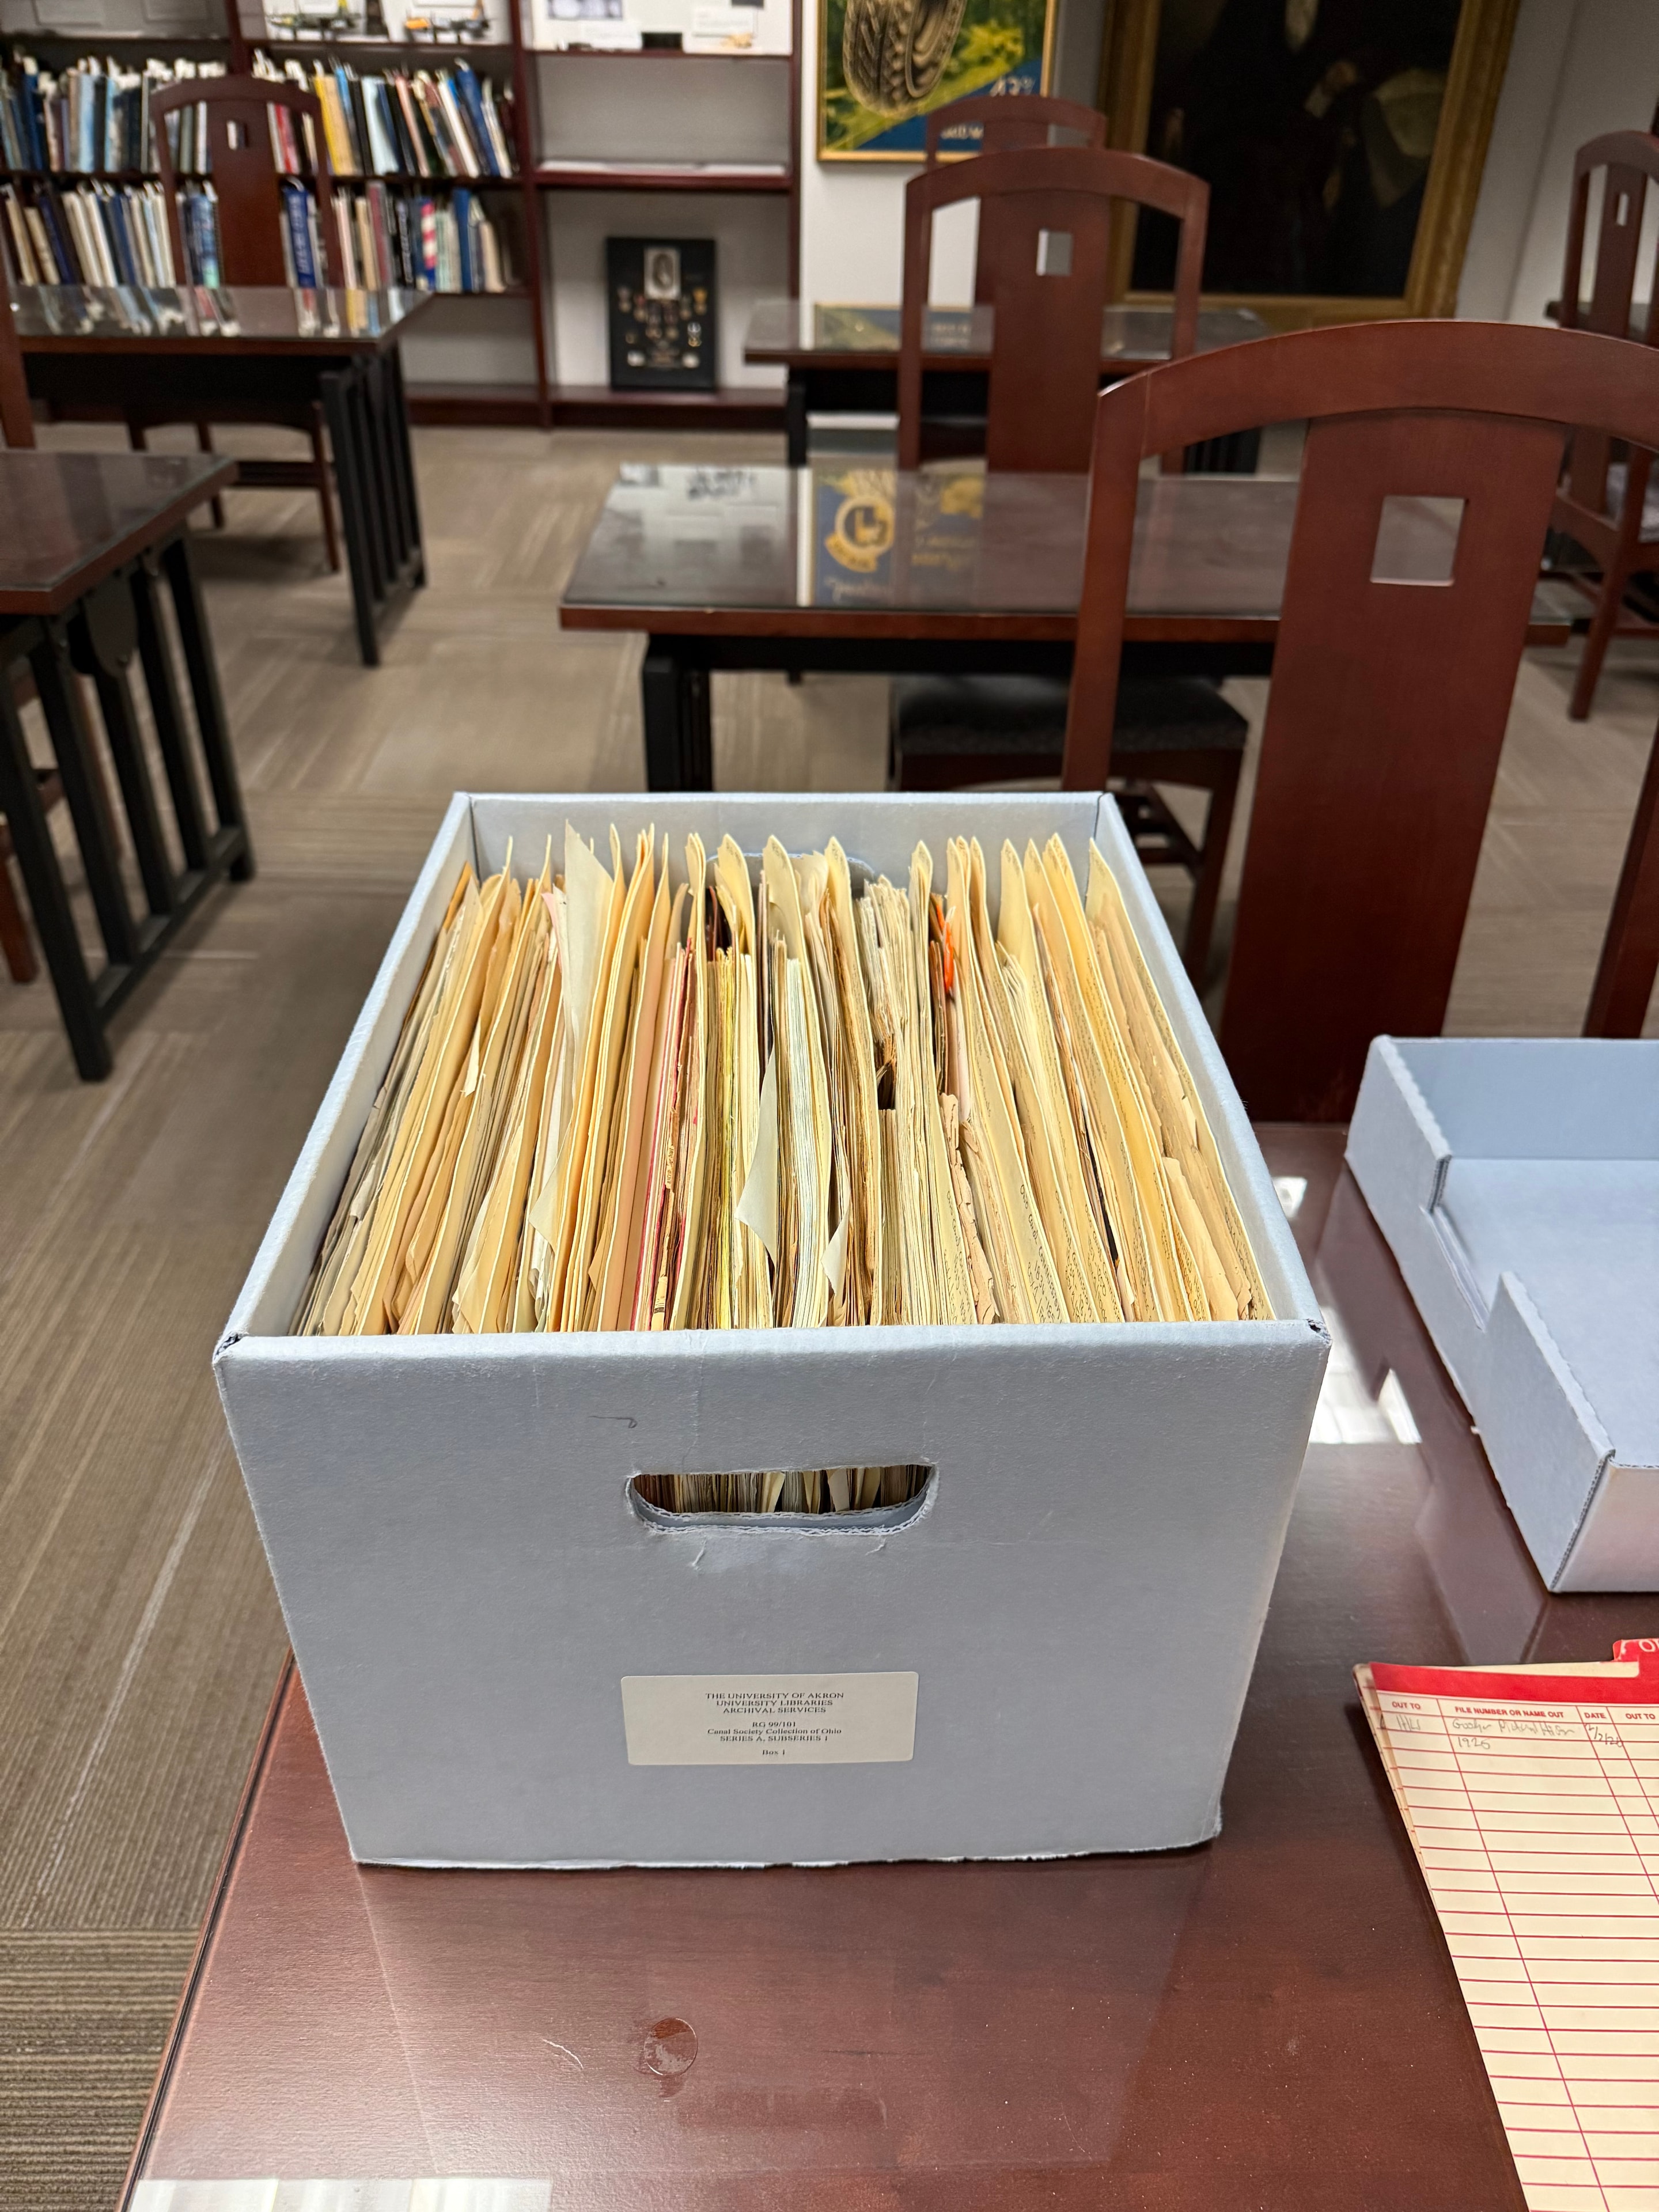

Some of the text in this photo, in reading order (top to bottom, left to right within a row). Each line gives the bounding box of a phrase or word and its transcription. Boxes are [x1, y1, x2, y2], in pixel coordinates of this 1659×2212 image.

[1392, 1701, 1407, 1709] OUT
[1455, 1706, 1472, 1714] FILE
[1474, 1707, 1508, 1716] NUMBER
[1522, 1710, 1547, 1718] NAME
